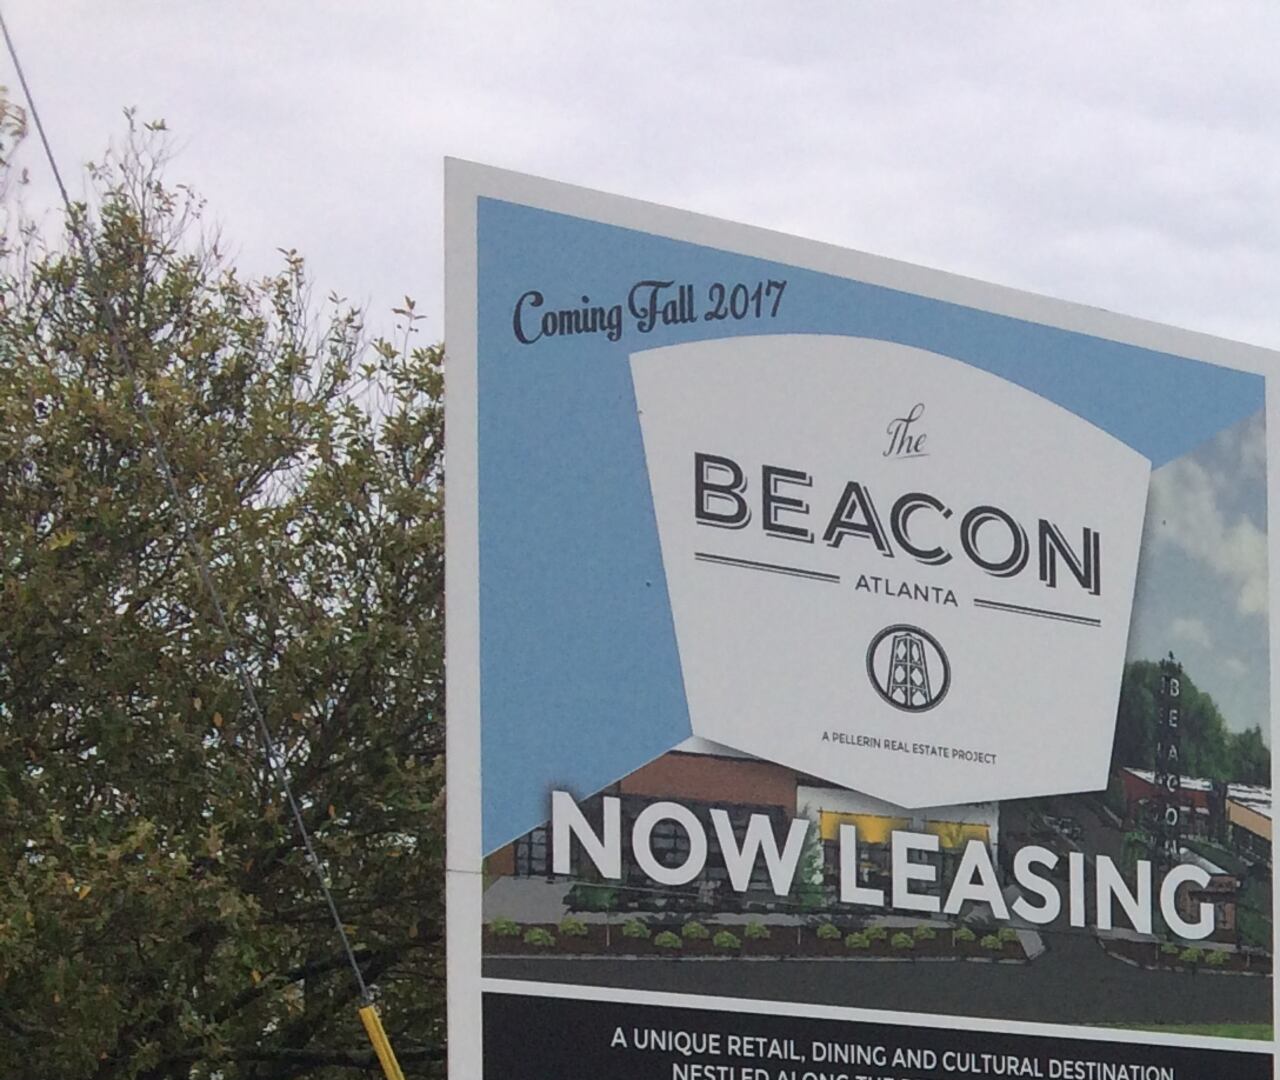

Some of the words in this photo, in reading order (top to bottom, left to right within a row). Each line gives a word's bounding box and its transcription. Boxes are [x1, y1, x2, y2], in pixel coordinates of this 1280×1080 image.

[512, 290, 623, 344] Coming
[627, 280, 698, 333] Fall
[704, 279, 787, 321] 2017
[882, 402, 930, 458] The
[694, 452, 1101, 597] BEACON
[855, 574, 959, 607] ATLANTA
[822, 731, 829, 742] A
[832, 732, 881, 749] PELLERIN
[883, 739, 910, 753] REAL
[912, 743, 950, 759] ESTATE
[952, 748, 997, 765] PROJECT
[552, 790, 810, 897] NOW
[838, 824, 1215, 941] LEASING
[611, 1026, 628, 1048] A
[633, 1028, 721, 1056] UNIQUE
[727, 1035, 806, 1063] RETAIL,
[812, 1041, 887, 1067] DINING
[892, 1047, 937, 1070] AND
[942, 1051, 1043, 1078] CULTURAL
